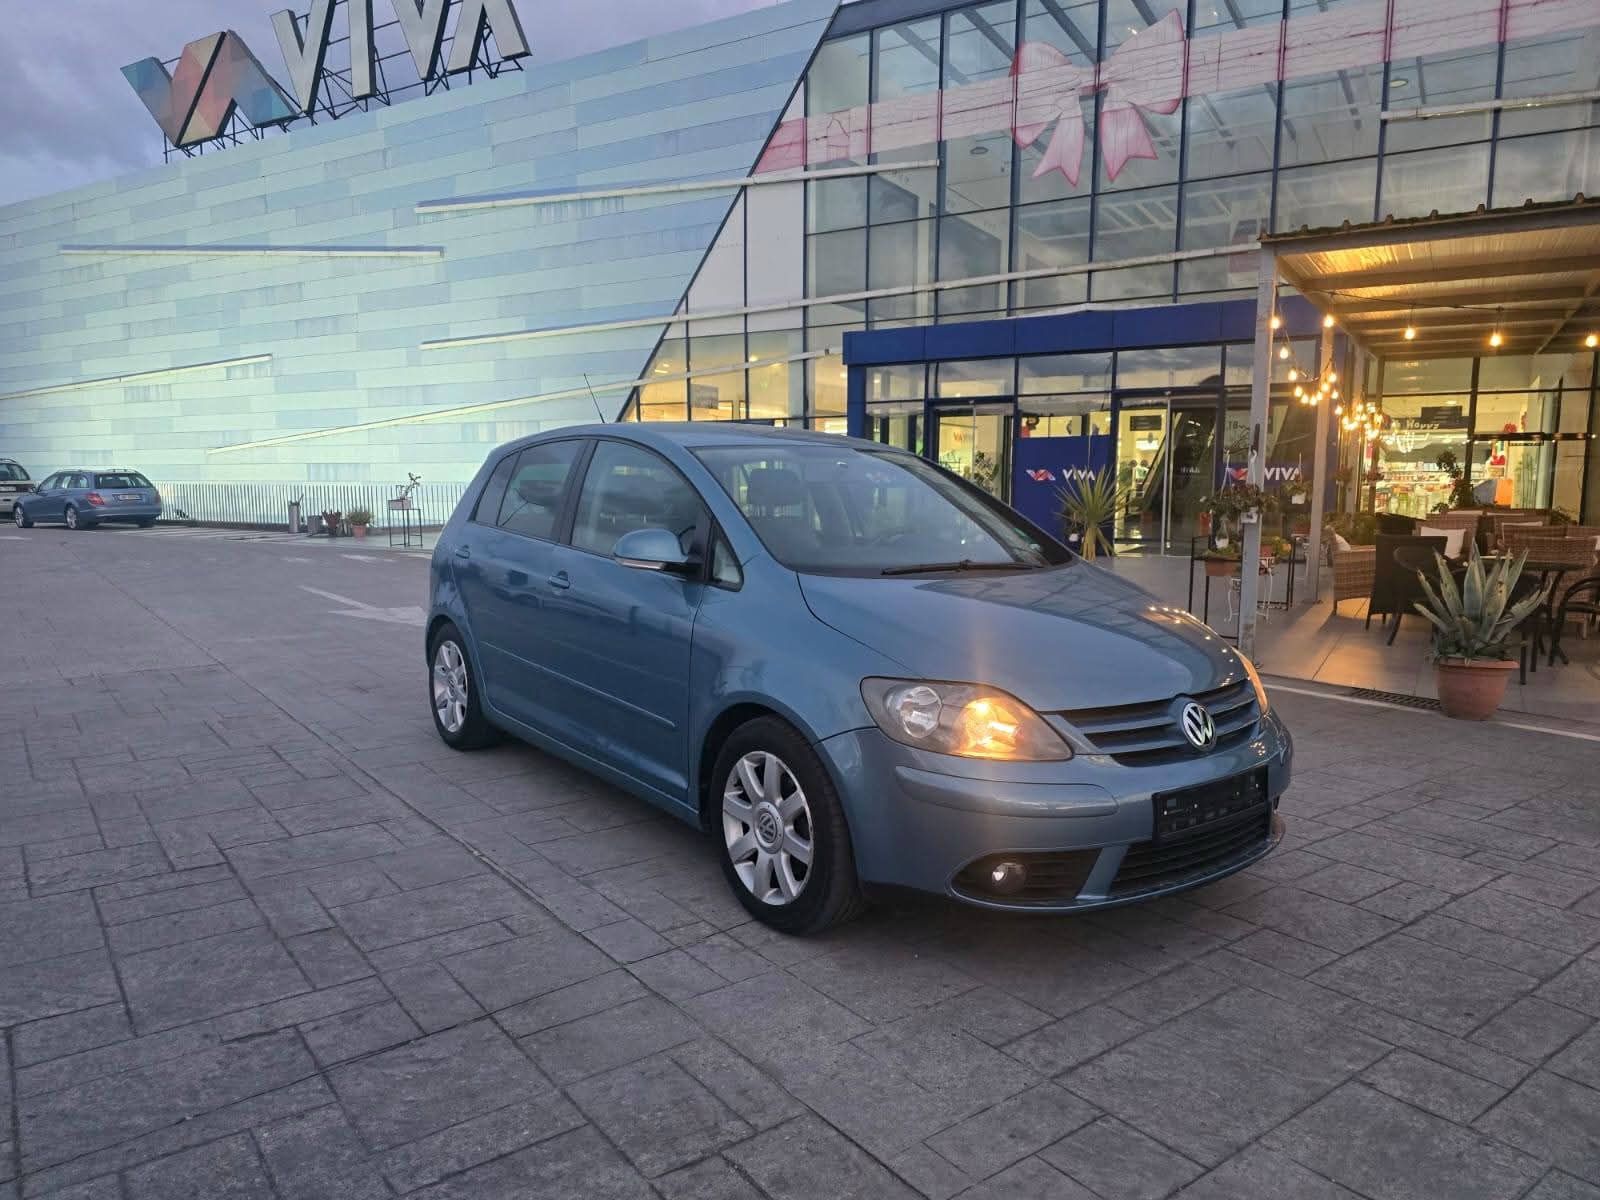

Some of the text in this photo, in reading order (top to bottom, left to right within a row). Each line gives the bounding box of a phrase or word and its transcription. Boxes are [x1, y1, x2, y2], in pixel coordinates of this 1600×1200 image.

[1062, 467, 1096, 481] VIVA
[1264, 467, 1301, 481] VIVA
[1183, 702, 1215, 749] VW
